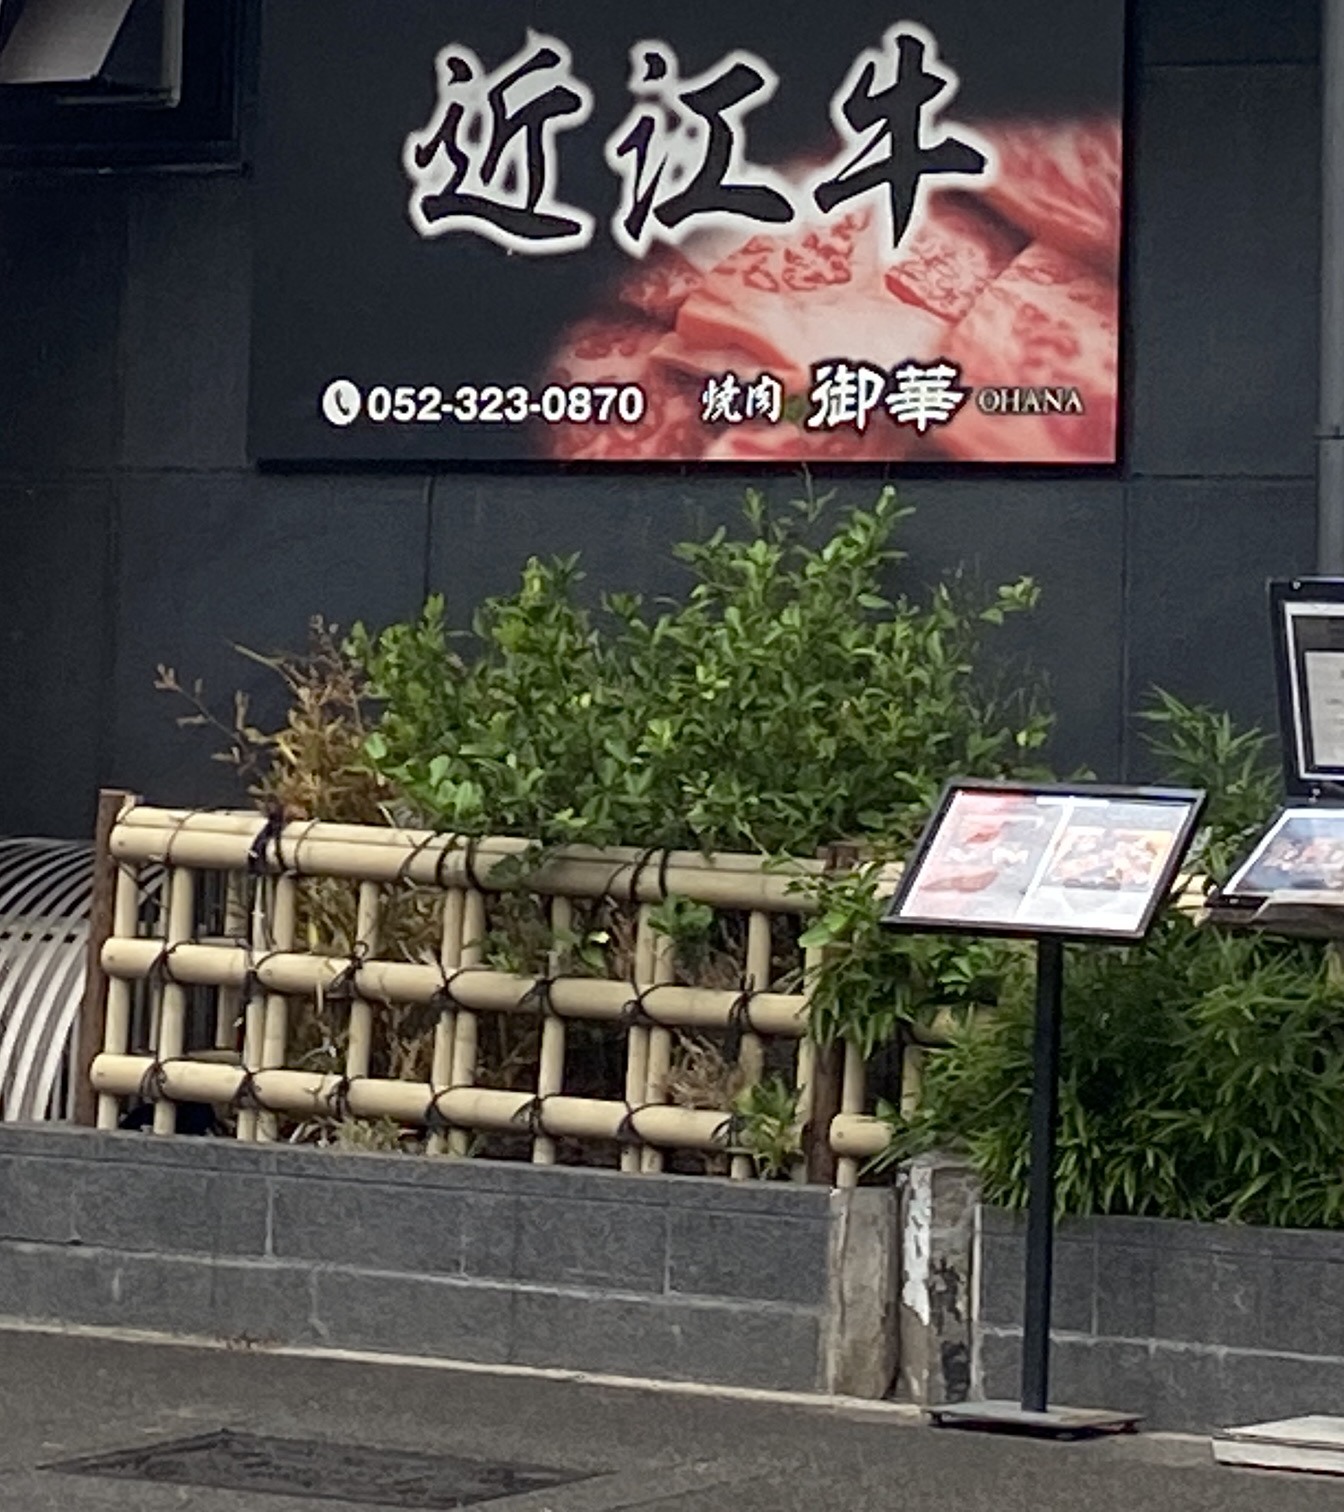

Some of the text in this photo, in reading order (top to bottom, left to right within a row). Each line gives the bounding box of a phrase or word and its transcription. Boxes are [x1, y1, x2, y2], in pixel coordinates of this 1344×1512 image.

[407, 24, 995, 255] 近江牛
[367, 385, 644, 422] 052-323-0870
[701, 364, 1083, 432] 焼肉 御華 OHANA
